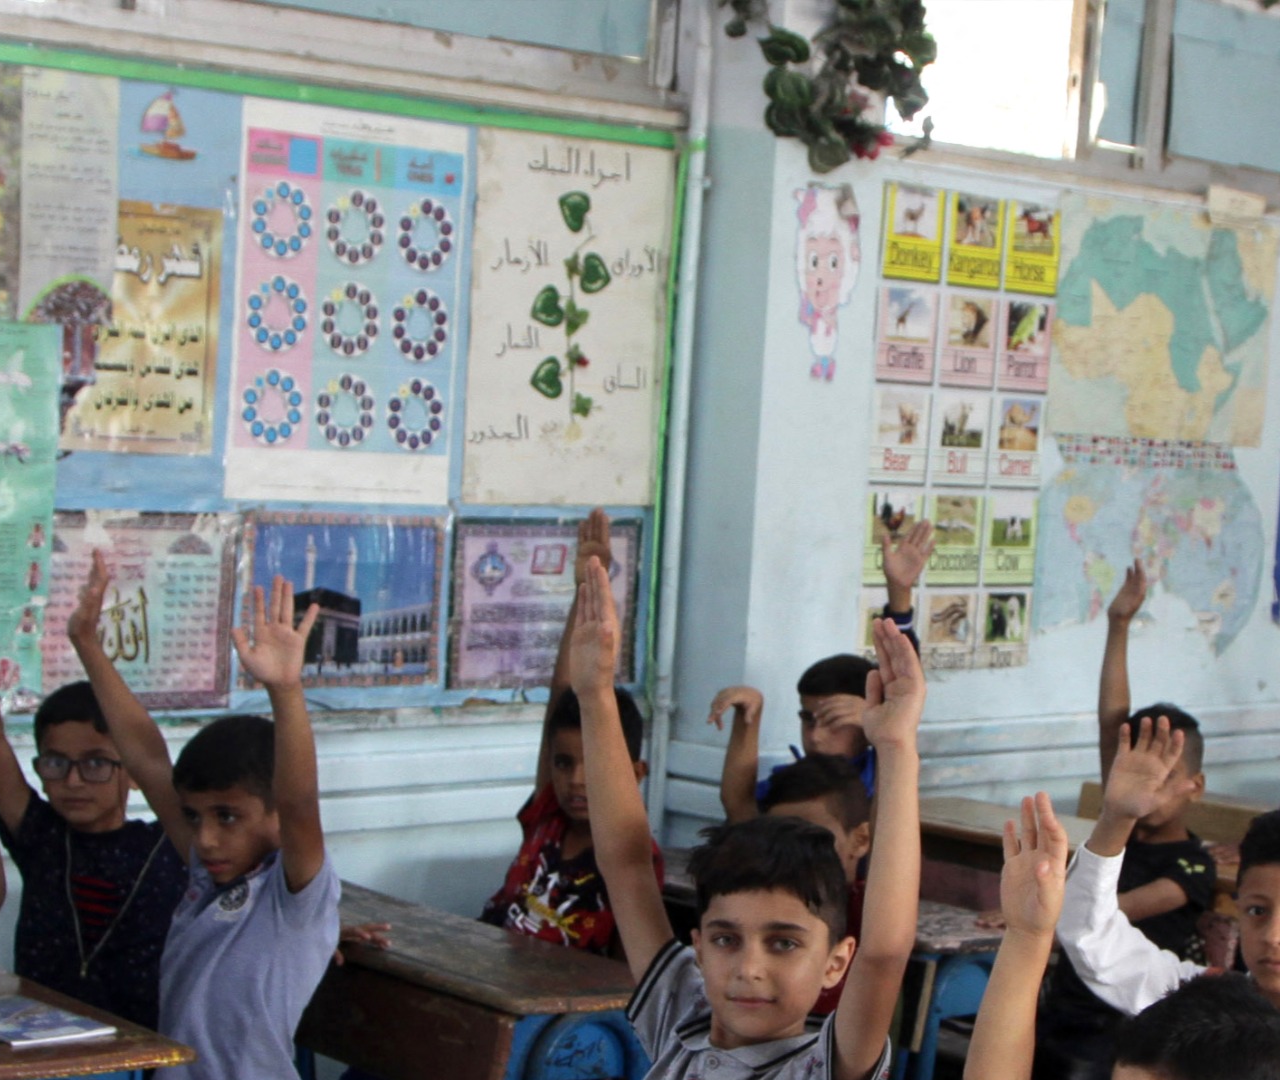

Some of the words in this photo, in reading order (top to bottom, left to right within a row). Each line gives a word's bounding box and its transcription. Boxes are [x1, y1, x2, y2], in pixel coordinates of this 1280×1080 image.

[890, 242, 934, 273] Donkey
[949, 254, 1001, 279] Kangaroo
[1013, 260, 1046, 283] Horse
[886, 344, 926, 370] Giraffe
[952, 350, 978, 373] Lion
[1006, 356, 1039, 379] Parrot
[882, 447, 911, 472] Bear
[946, 450, 968, 475] Bull
[998, 454, 1033, 476] Camel
[929, 548, 980, 571] Crocodile
[995, 549, 1021, 572] Cow
